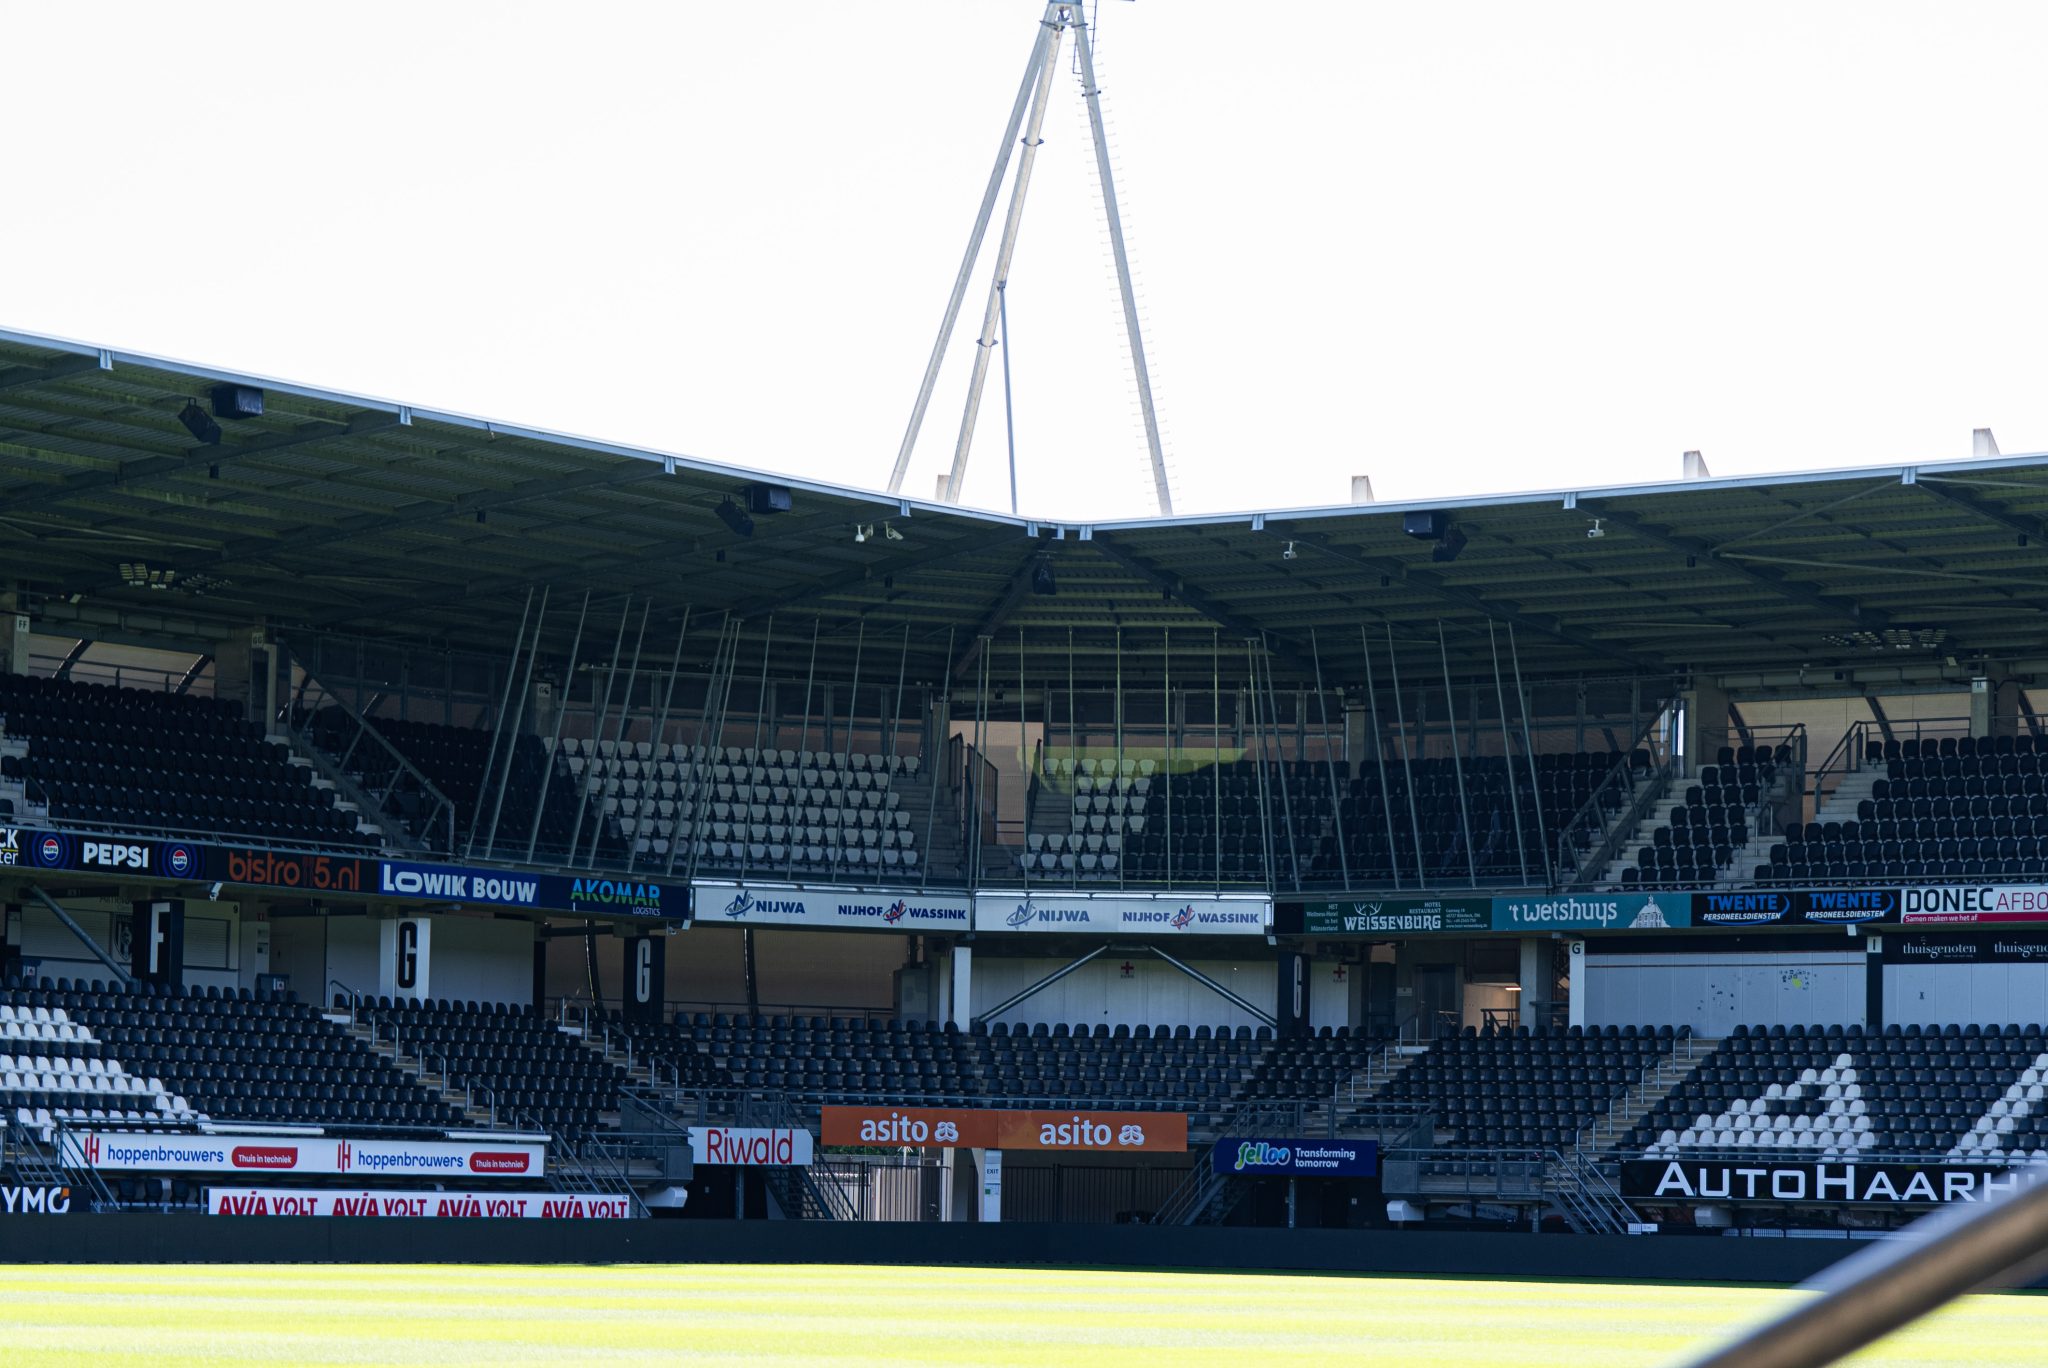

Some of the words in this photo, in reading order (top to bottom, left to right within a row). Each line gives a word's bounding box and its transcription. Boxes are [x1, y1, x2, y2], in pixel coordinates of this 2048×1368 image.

[18, 619, 28, 630] FF
[83, 841, 149, 868] PEPSI
[383, 863, 468, 897] LOWIK
[472, 877, 537, 903] BOUW
[570, 877, 661, 907] AKOMAR
[1809, 891, 1883, 909] TWENTE
[1906, 887, 1994, 912] DONEC
[756, 899, 806, 914] NIJWA
[1706, 894, 1779, 911] TWENTE
[632, 906, 662, 917] LOGISTICS
[838, 904, 883, 917] NIJHOF
[908, 907, 967, 920] WASSINK
[1038, 909, 1091, 923] NIJWA
[1122, 911, 1171, 924] NIJHOF
[1197, 912, 1259, 924] WASSINK
[1703, 912, 1781, 921] PERSONEELSDIENSTEN
[1805, 910, 1885, 919] PERSONEELSDIENSTEN
[1905, 914, 1928, 923] Samen
[1927, 914, 1948, 923] maken
[1948, 914, 1959, 922] we
[1959, 913, 1970, 922] het
[1971, 912, 1979, 921] af
[1343, 914, 1442, 931] WEISSENBURG
[150, 901, 171, 974] F
[397, 921, 417, 989] G
[1572, 942, 1582, 955] G
[1903, 941, 1977, 959] thuisgenoten
[636, 938, 651, 1003] G
[860, 1112, 929, 1143] asito
[1039, 1115, 1112, 1145] asito
[107, 1144, 224, 1165] hoppenbrouwers
[707, 1128, 793, 1164] Riwald
[1295, 1147, 1356, 1161] Transforming
[238, 1153, 256, 1164] Thuis
[256, 1155, 263, 1163] in
[263, 1154, 292, 1165] techniek
[358, 1150, 464, 1170] hoppenbrouwers
[475, 1159, 492, 1169] Thuis
[492, 1160, 498, 1168] in
[498, 1160, 525, 1170] techniek
[1295, 1158, 1340, 1168] tomorrow
[272, 1196, 318, 1216] VOLT
[383, 1198, 427, 1217] VOLT
[485, 1200, 527, 1218] VOLT
[588, 1201, 628, 1219] VOLT
